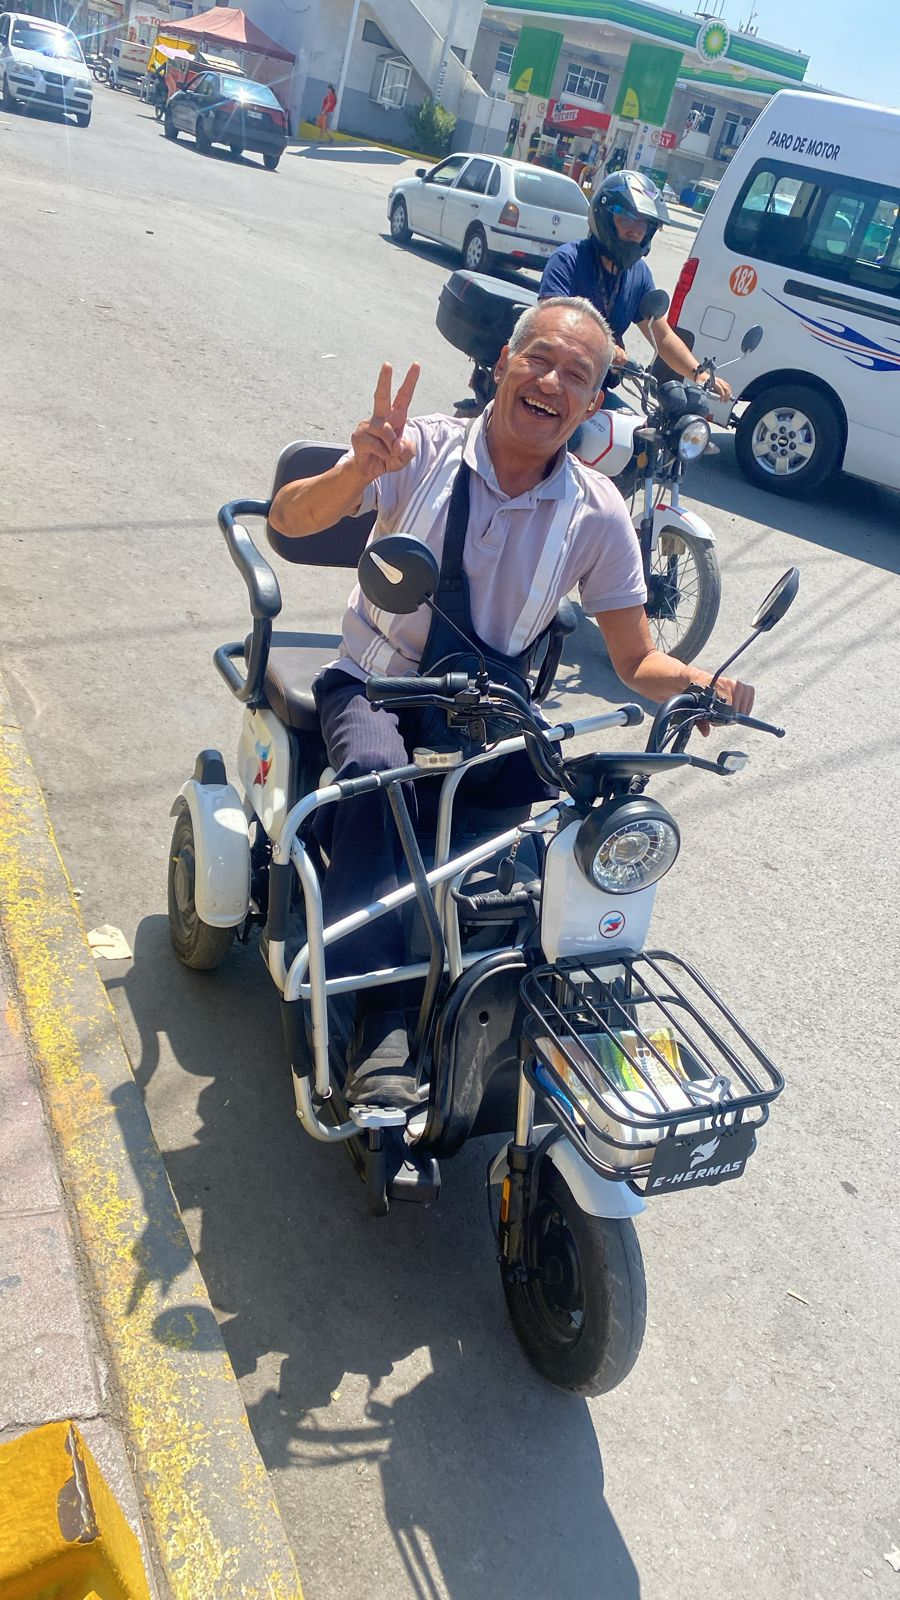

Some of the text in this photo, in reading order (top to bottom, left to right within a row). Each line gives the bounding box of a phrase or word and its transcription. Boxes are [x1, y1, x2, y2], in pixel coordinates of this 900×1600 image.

[553, 111, 578, 121] TECATE
[767, 130, 841, 160] PARO DE MOTOR
[733, 266, 754, 294] 182
[652, 1160, 742, 1188] E-HERMAS
